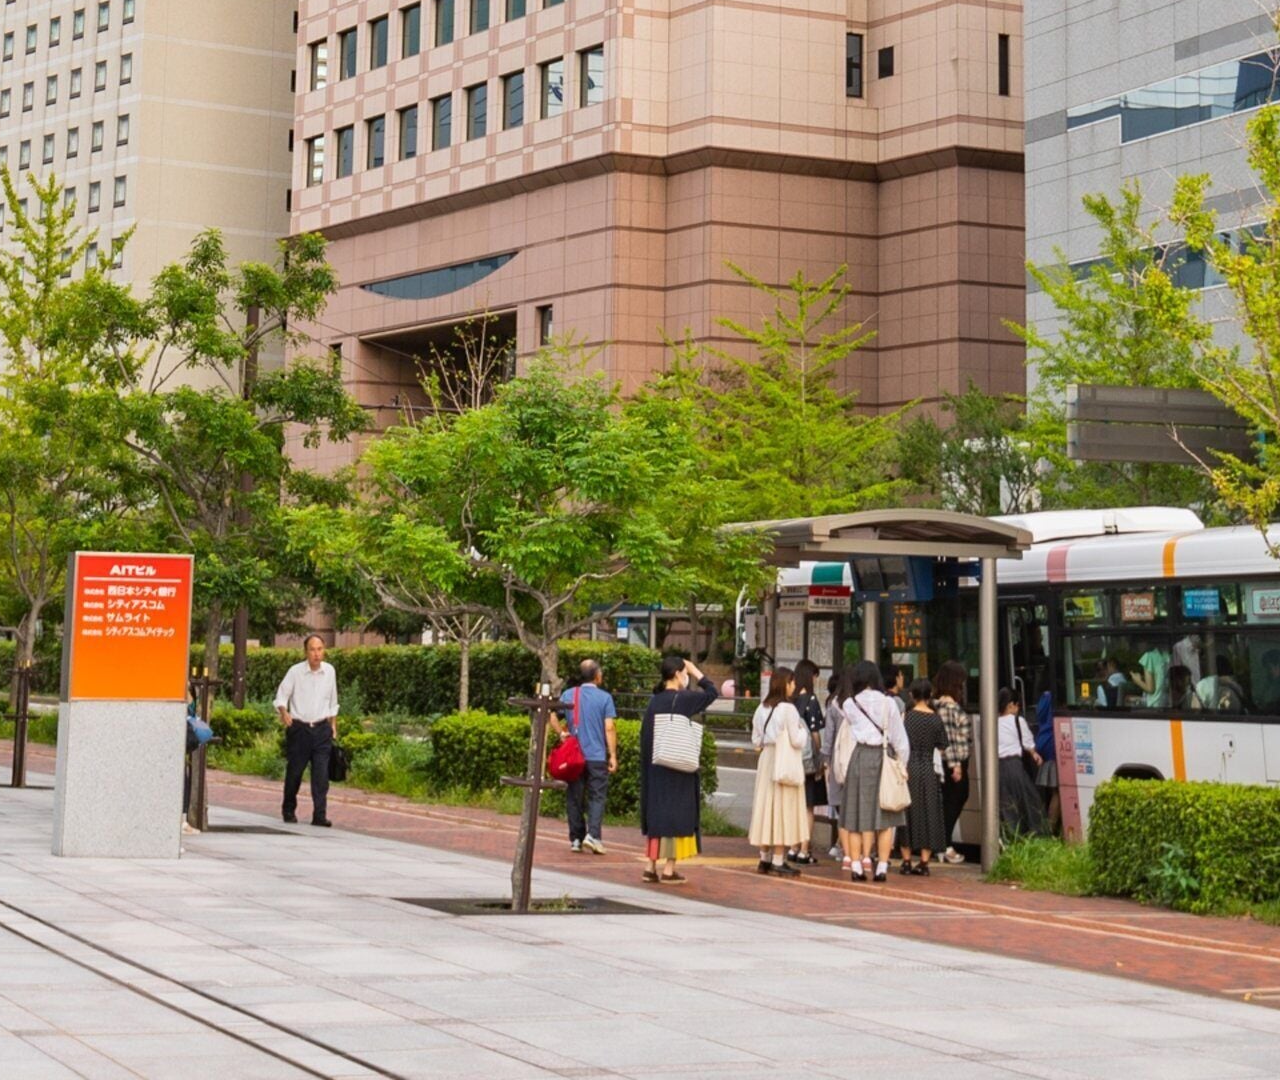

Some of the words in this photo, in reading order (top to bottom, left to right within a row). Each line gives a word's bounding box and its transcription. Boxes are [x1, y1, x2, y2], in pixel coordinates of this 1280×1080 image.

[109, 565, 156, 576] AITビル
[108, 585, 176, 597] 西日本シティ銀行
[108, 599, 165, 610] シティアスコム
[107, 613, 150, 623] サムライト
